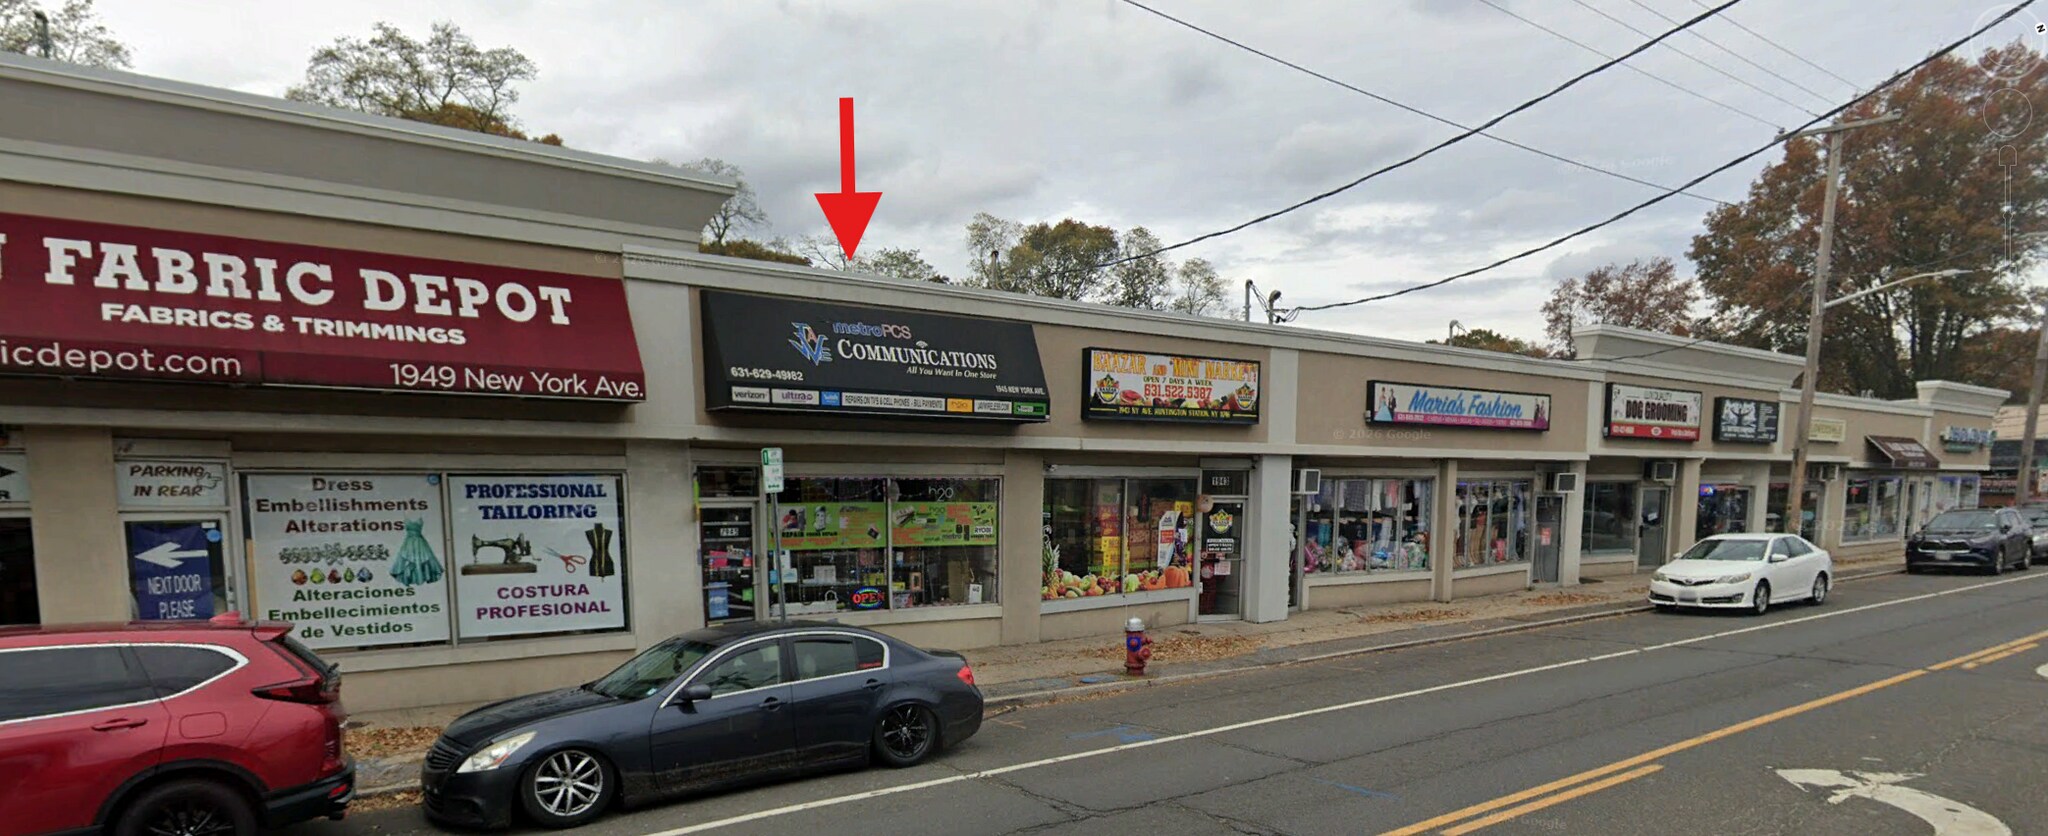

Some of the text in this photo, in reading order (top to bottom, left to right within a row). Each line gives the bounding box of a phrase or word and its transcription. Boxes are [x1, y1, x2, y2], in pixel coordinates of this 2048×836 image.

[42, 237, 334, 306] FABRIC
[359, 268, 572, 326] DEPOT
[101, 303, 467, 345] FABRICS & TRIMMINGS
[832, 321, 912, 340] metroPCS
[837, 339, 998, 370] COMMUNICATIONS
[1093, 351, 1147, 376] BAAZAR
[389, 363, 644, 398] 1949 New York Ave.
[906, 365, 997, 380] All You Want In One Store
[1143, 376, 1160, 384] OPEN
[734, 390, 766, 400] verizon
[1008, 386, 1019, 394] NEW
[1020, 386, 1034, 395] YORK
[1143, 383, 1213, 400] 631.522.5387
[1408, 389, 1523, 418] Maria's Fashion
[1625, 400, 1688, 422] DOG GROOMING
[129, 465, 205, 478] PARKING
[133, 485, 203, 497] IN REAR
[312, 477, 374, 492] Dress
[465, 483, 608, 499] PROFESSIONAL
[256, 498, 429, 513] Embellishments
[478, 504, 598, 520] TAILORING
[285, 518, 405, 534] Alterations
[148, 574, 202, 595] NEXT DOOR
[497, 583, 590, 600] COSTURA
[292, 586, 416, 602] Alteraciones
[852, 591, 885, 604] OPEN
[159, 599, 196, 620] PLEASE
[268, 602, 441, 622] Embellecimientos
[476, 600, 611, 620] PROFESIONAL
[301, 622, 414, 639] de Vestidos
